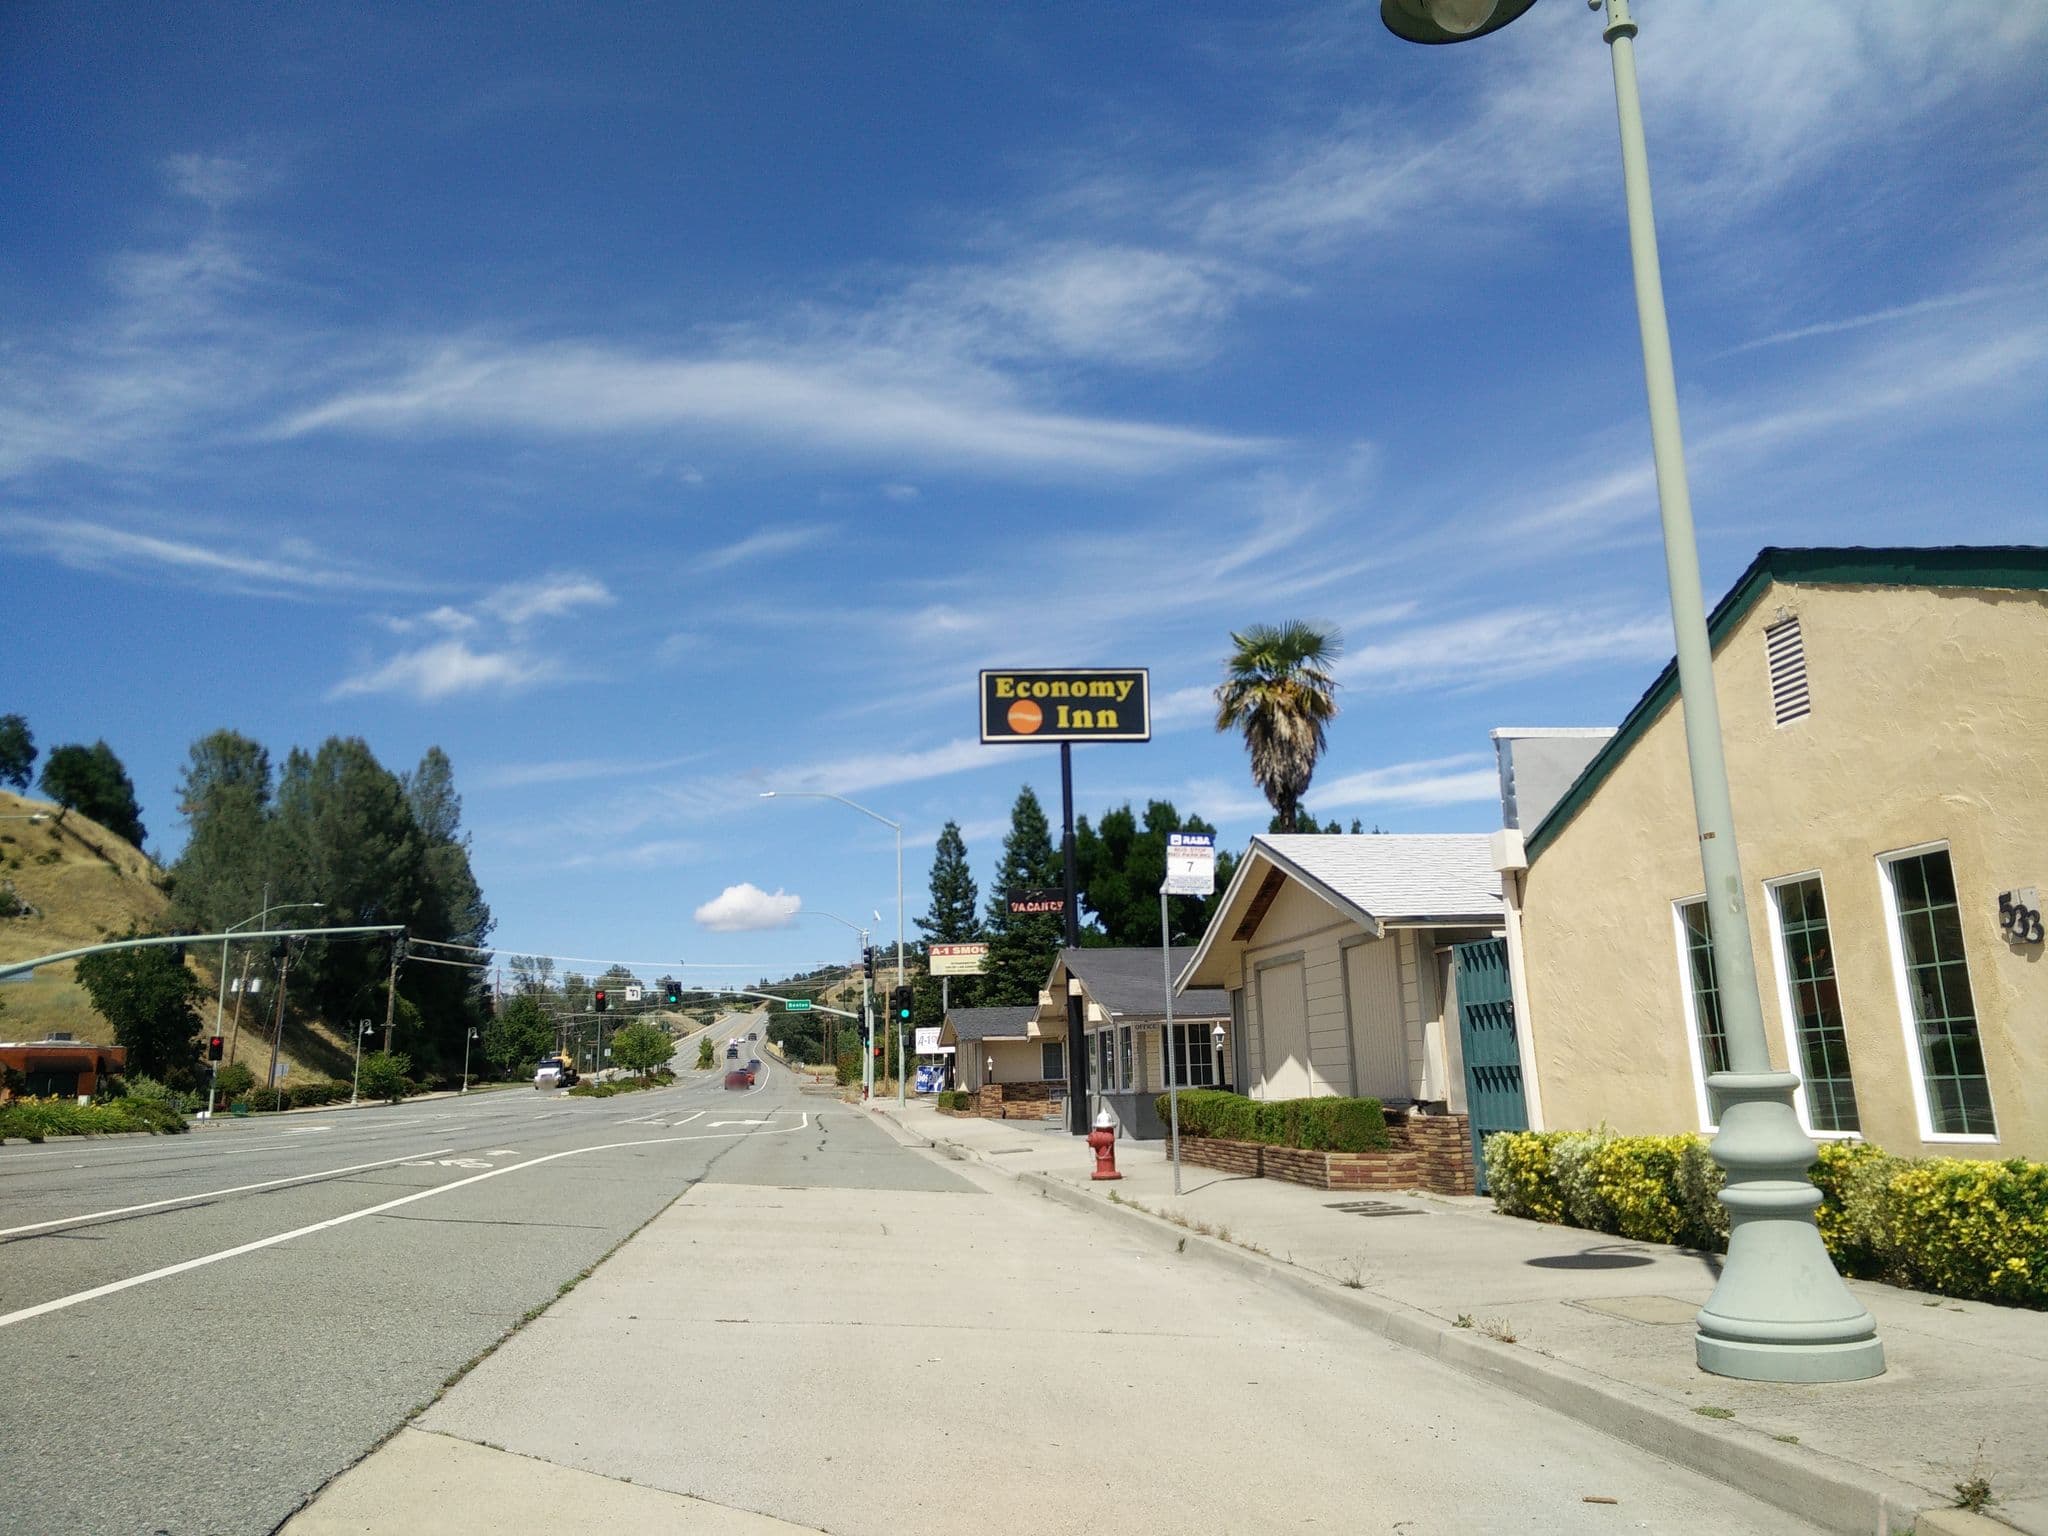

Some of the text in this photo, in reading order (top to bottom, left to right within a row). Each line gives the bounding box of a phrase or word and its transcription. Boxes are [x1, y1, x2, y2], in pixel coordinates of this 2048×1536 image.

[995, 677, 1134, 702] Economy
[1056, 705, 1119, 728] Inn
[1182, 835, 1211, 846] RABA
[1187, 861, 1194, 872] 7
[1011, 901, 1064, 912] VACANCY
[1998, 891, 2045, 944] 533
[931, 947, 950, 955] A-1
